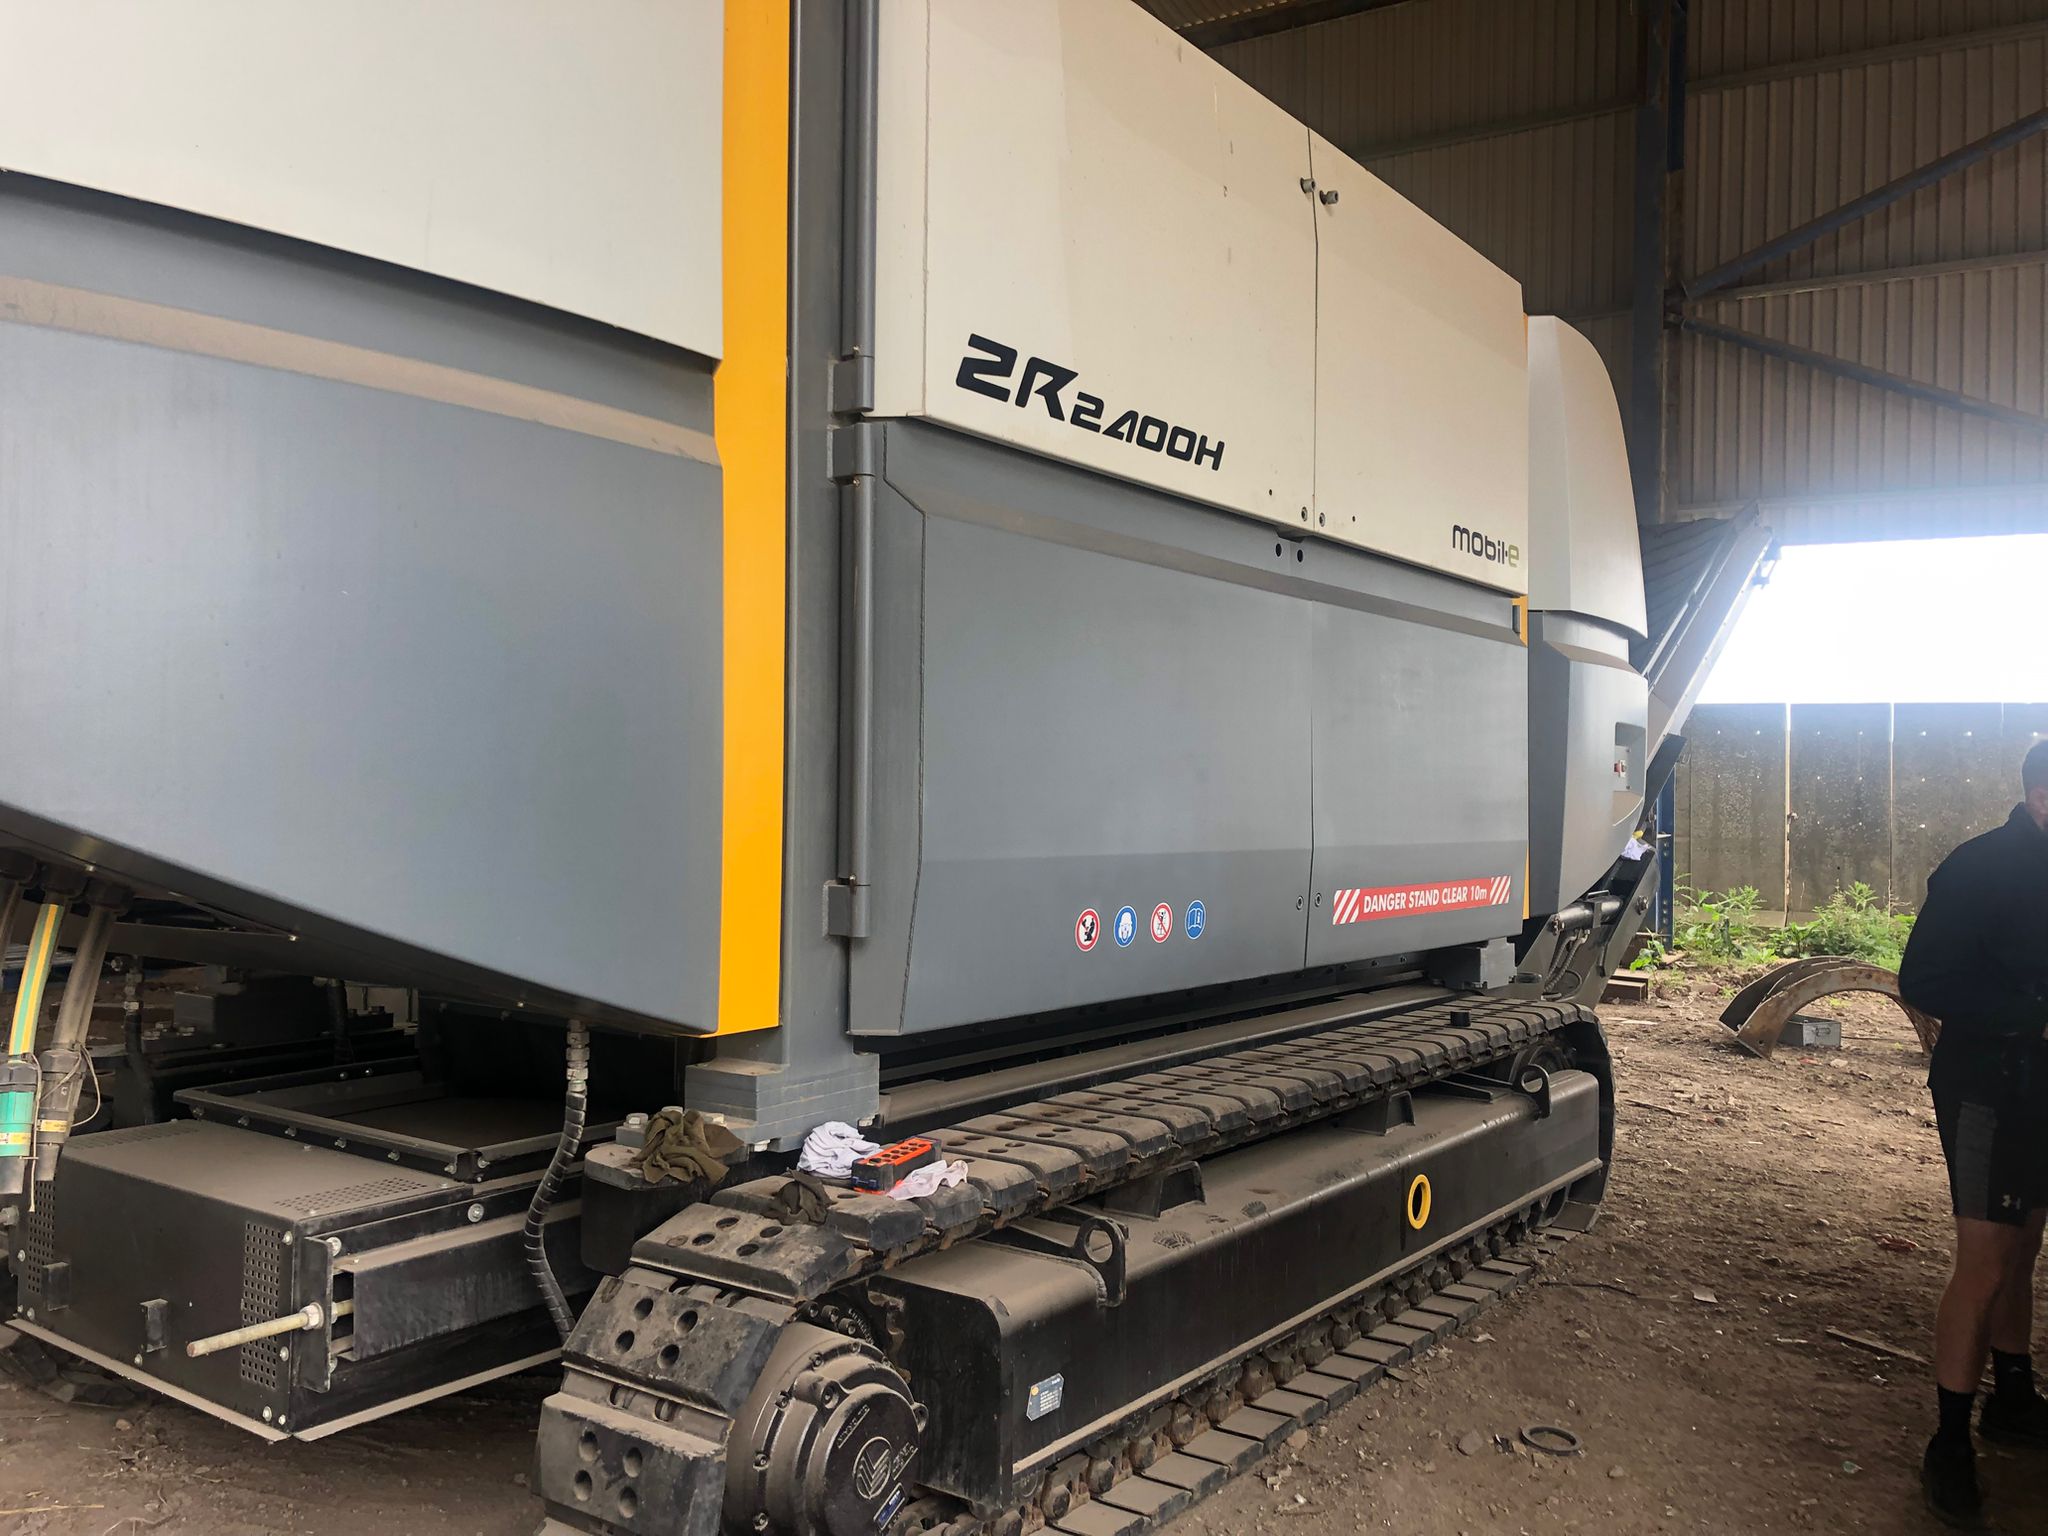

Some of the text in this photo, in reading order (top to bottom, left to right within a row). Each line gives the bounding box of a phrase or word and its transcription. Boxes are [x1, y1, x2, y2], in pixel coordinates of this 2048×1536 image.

[1363, 885, 1487, 913] DANGER STAND CLEAR 10m
